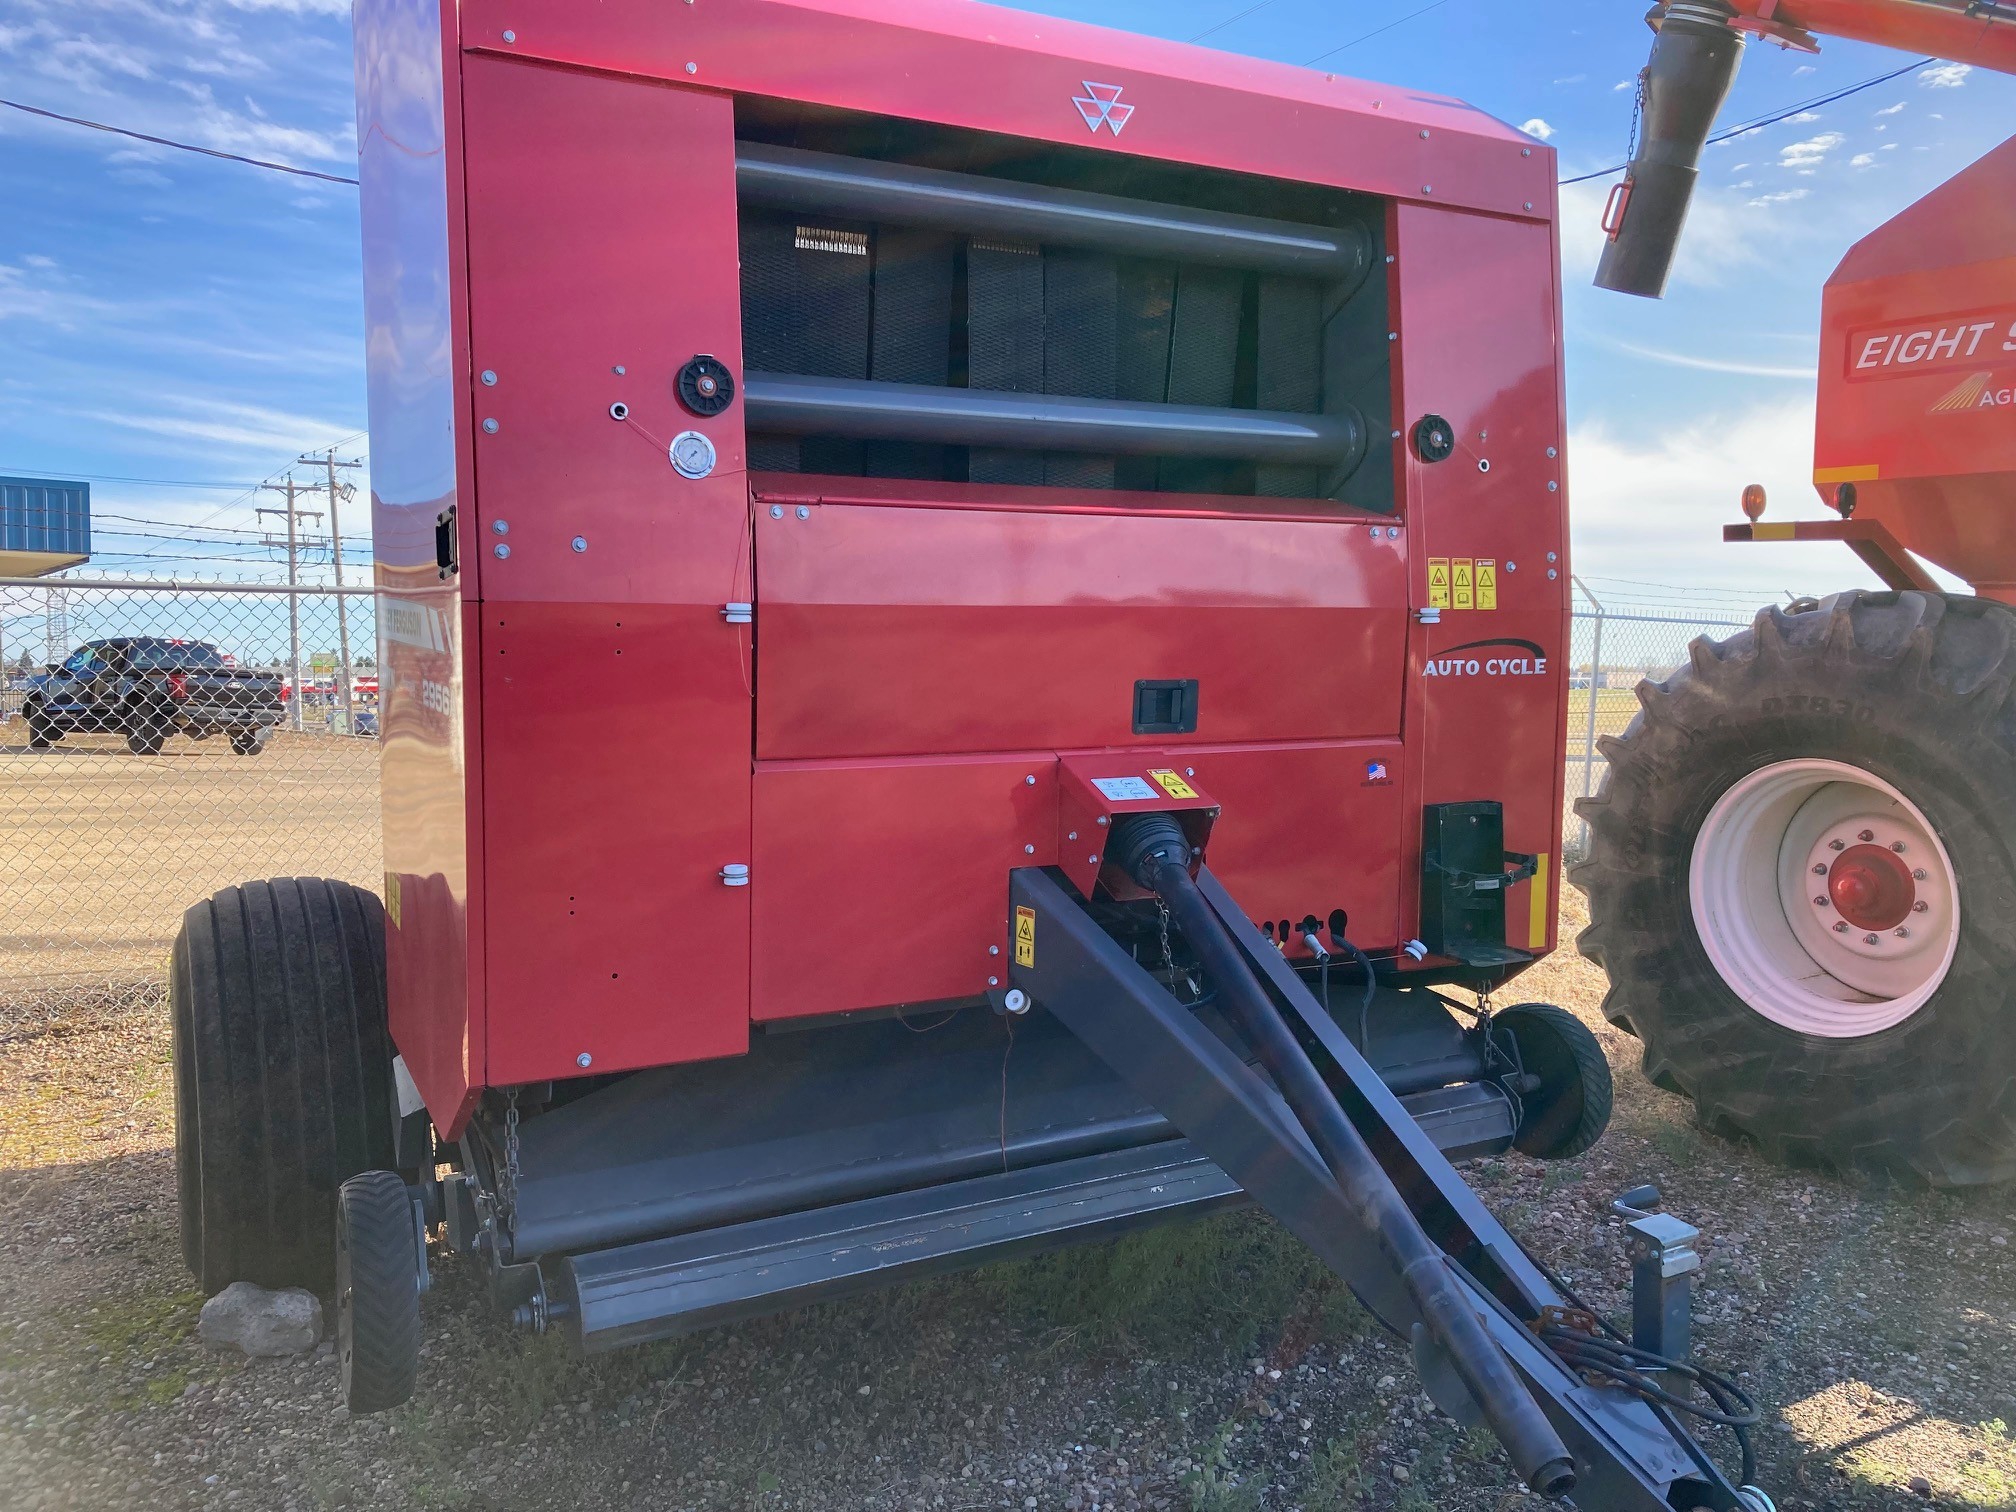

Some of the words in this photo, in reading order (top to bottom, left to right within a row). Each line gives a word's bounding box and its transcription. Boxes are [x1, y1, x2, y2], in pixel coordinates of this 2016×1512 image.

[1857, 322, 1994, 369] EIGHT
[1422, 660, 1479, 676] AUTO
[1485, 659, 1546, 675] CYCLE
